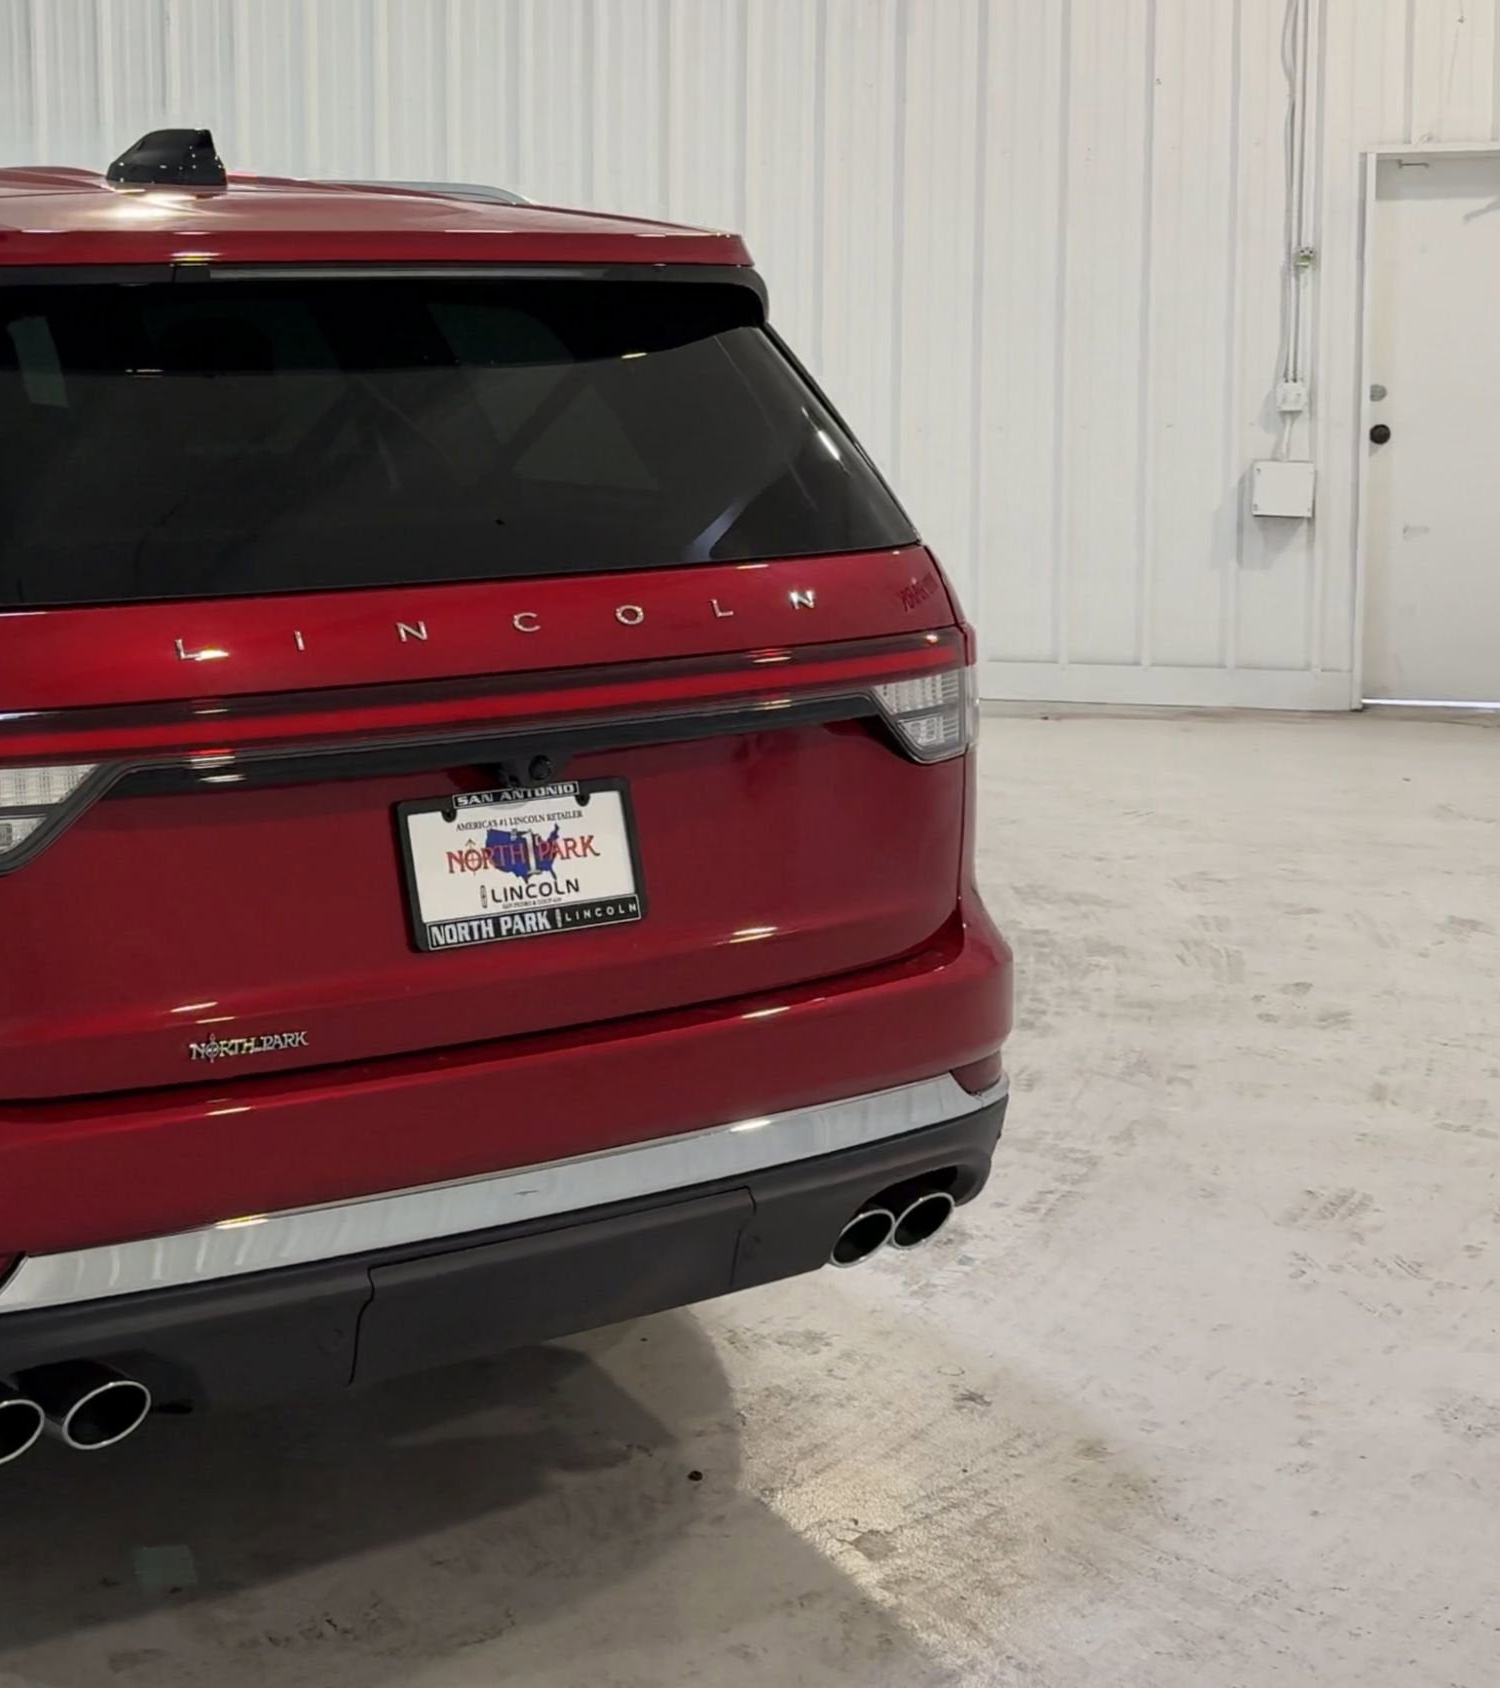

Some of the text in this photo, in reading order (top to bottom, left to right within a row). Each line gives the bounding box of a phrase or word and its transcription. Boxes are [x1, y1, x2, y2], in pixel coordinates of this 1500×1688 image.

[174, 590, 816, 661] LINCOLN
[457, 784, 575, 806] SAN ANTONIO
[456, 819, 498, 832] AMERICA'S
[509, 814, 546, 826] LINCOLN
[546, 810, 583, 821] RETAILER
[446, 835, 601, 874] NORTH PARK
[491, 878, 580, 903] LINCOLN
[431, 904, 637, 947] NORTH PARK LINCOLN
